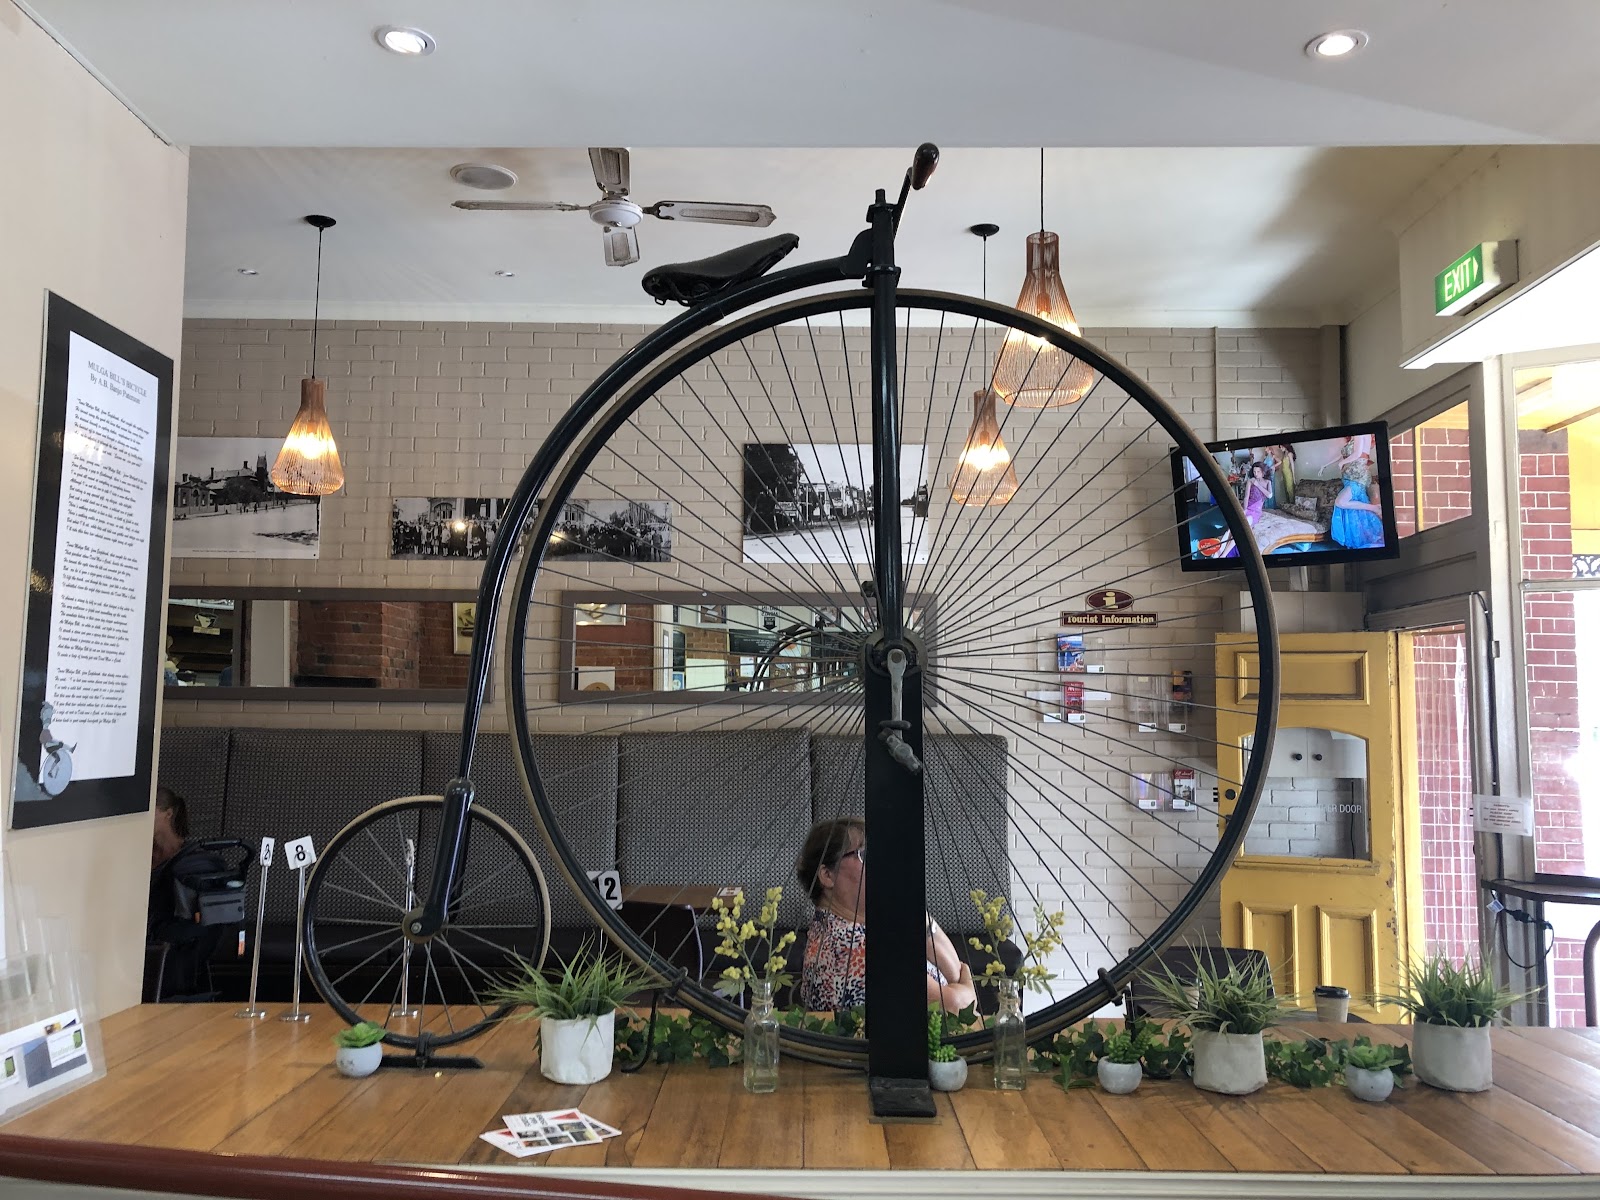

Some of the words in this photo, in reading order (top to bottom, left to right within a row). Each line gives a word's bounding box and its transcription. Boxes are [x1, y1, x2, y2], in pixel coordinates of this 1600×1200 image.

[1444, 257, 1471, 303] EXIT
[88, 360, 109, 377] MULGA
[109, 371, 126, 385] BILL'S
[126, 380, 147, 397] BICYCLE
[1067, 614, 1098, 623] Tourist
[1101, 614, 1154, 623] Information
[1339, 803, 1362, 814] DOOR
[296, 845, 306, 860] 8
